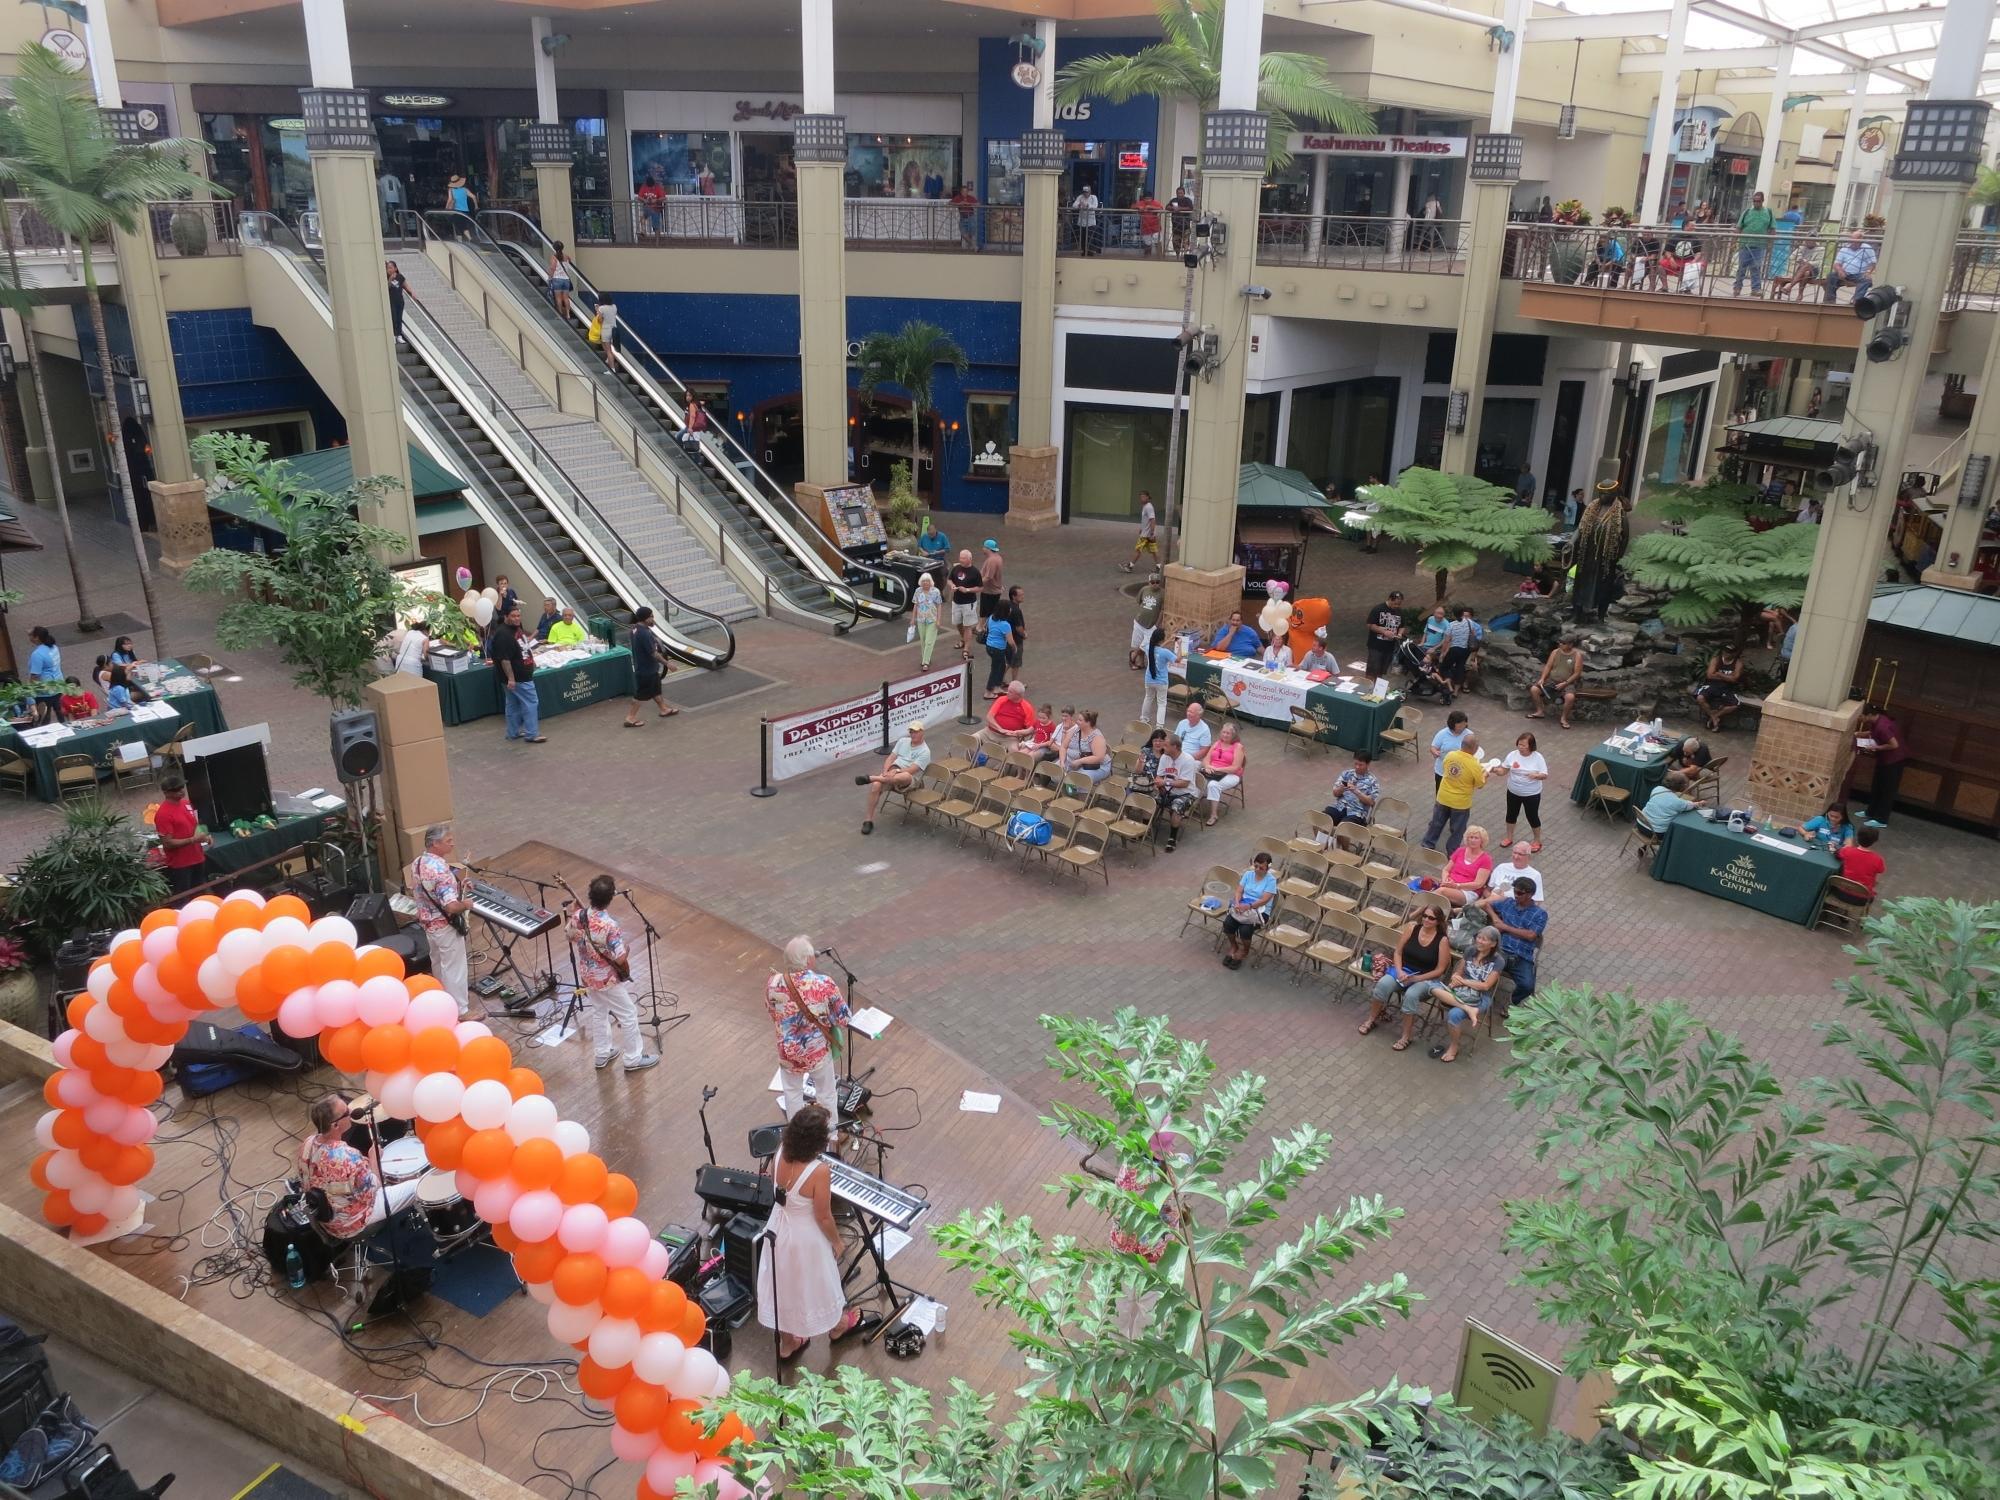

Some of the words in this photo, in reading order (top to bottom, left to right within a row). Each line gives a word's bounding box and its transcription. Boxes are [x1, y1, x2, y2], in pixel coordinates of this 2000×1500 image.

[1303, 135, 1386, 151] Kaahumanu
[1390, 137, 1451, 154] Theatres
[1248, 680, 1277, 694] National
[1279, 687, 1302, 700] Kidney
[1248, 690, 1284, 704] Foundation
[788, 731, 811, 743] DA
[815, 709, 867, 734] KIDNEY
[893, 689, 926, 707] KINE
[929, 678, 957, 695] DAY
[804, 734, 824, 747] THIS
[827, 719, 870, 738] SATURDAY
[1726, 863, 1756, 880] QUEEN
[1720, 878, 1752, 895] CENTER
